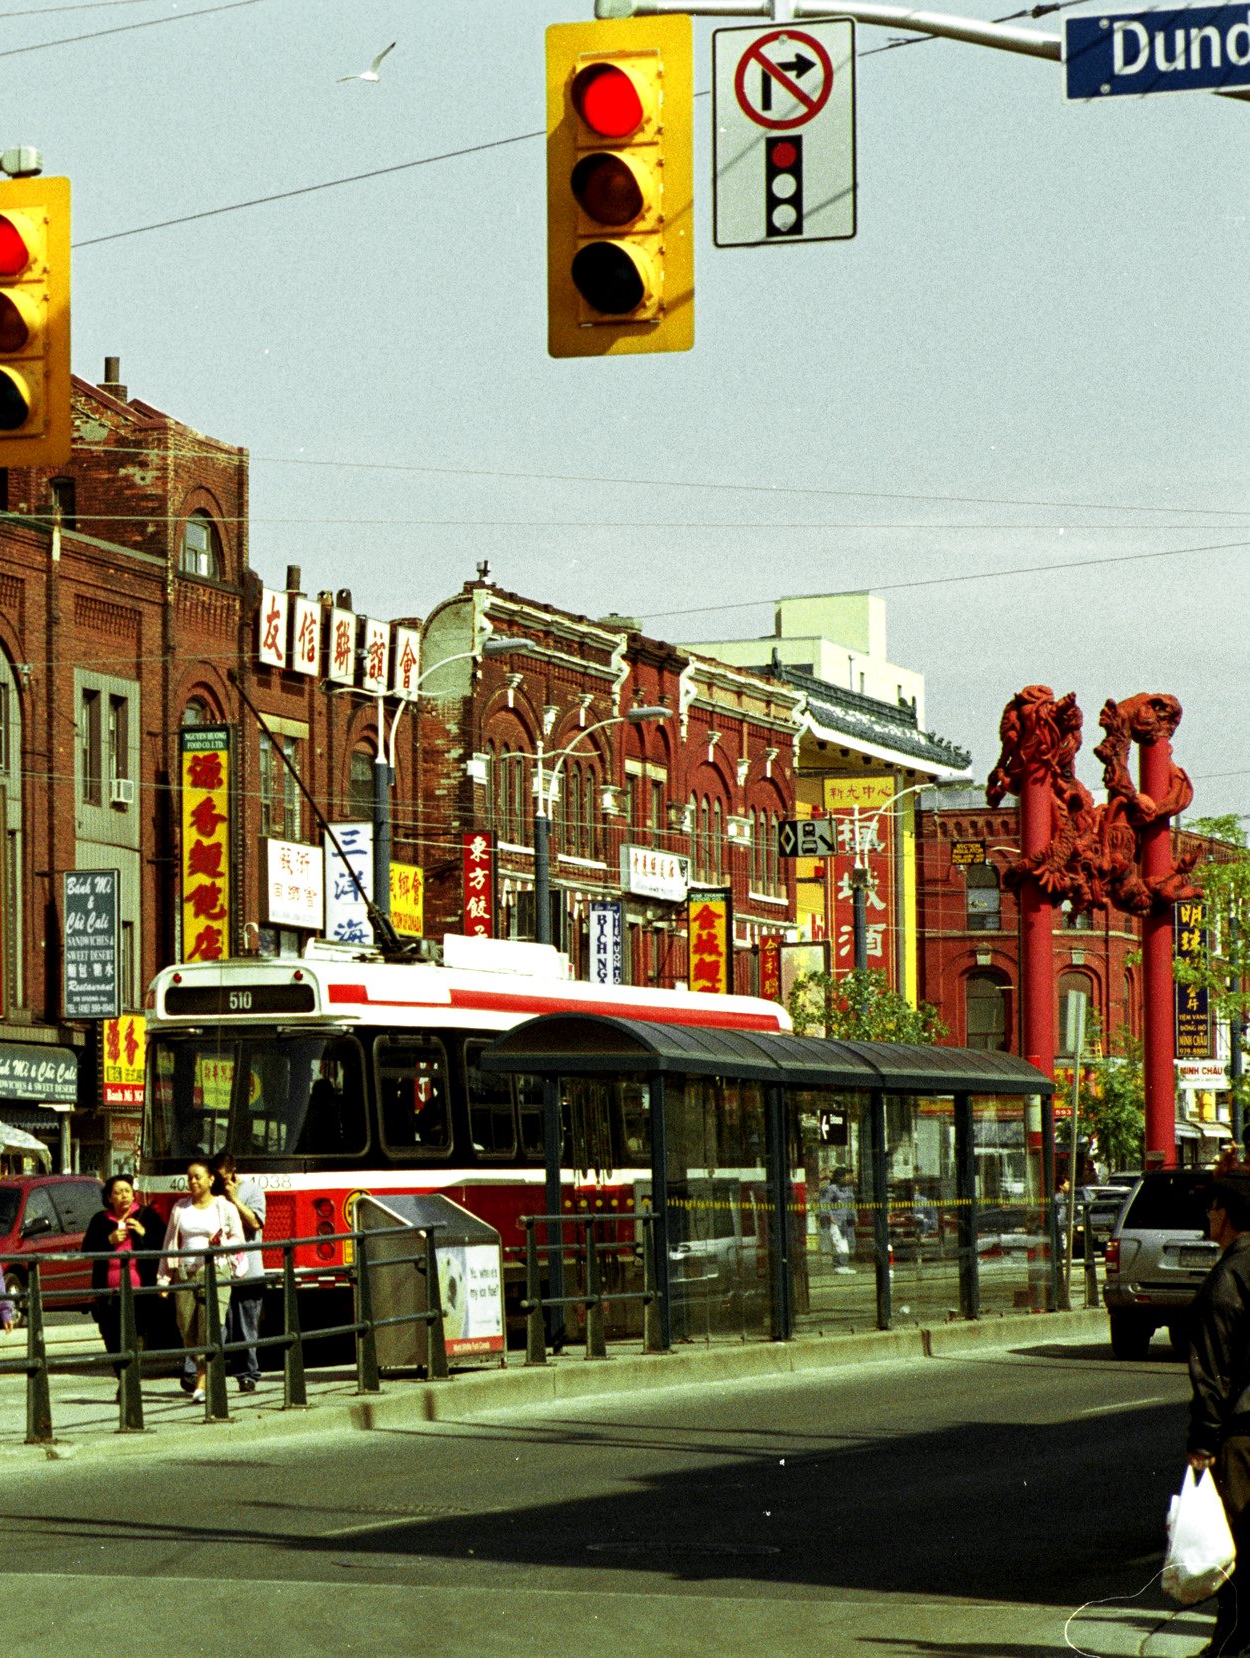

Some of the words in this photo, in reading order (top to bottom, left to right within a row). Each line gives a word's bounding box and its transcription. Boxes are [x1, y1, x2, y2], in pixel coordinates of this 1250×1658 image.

[67, 949, 89, 961] SWEET
[229, 991, 252, 1010] 510
[34, 1082, 53, 1092] SWEET
[54, 1084, 77, 1094] DESERT
